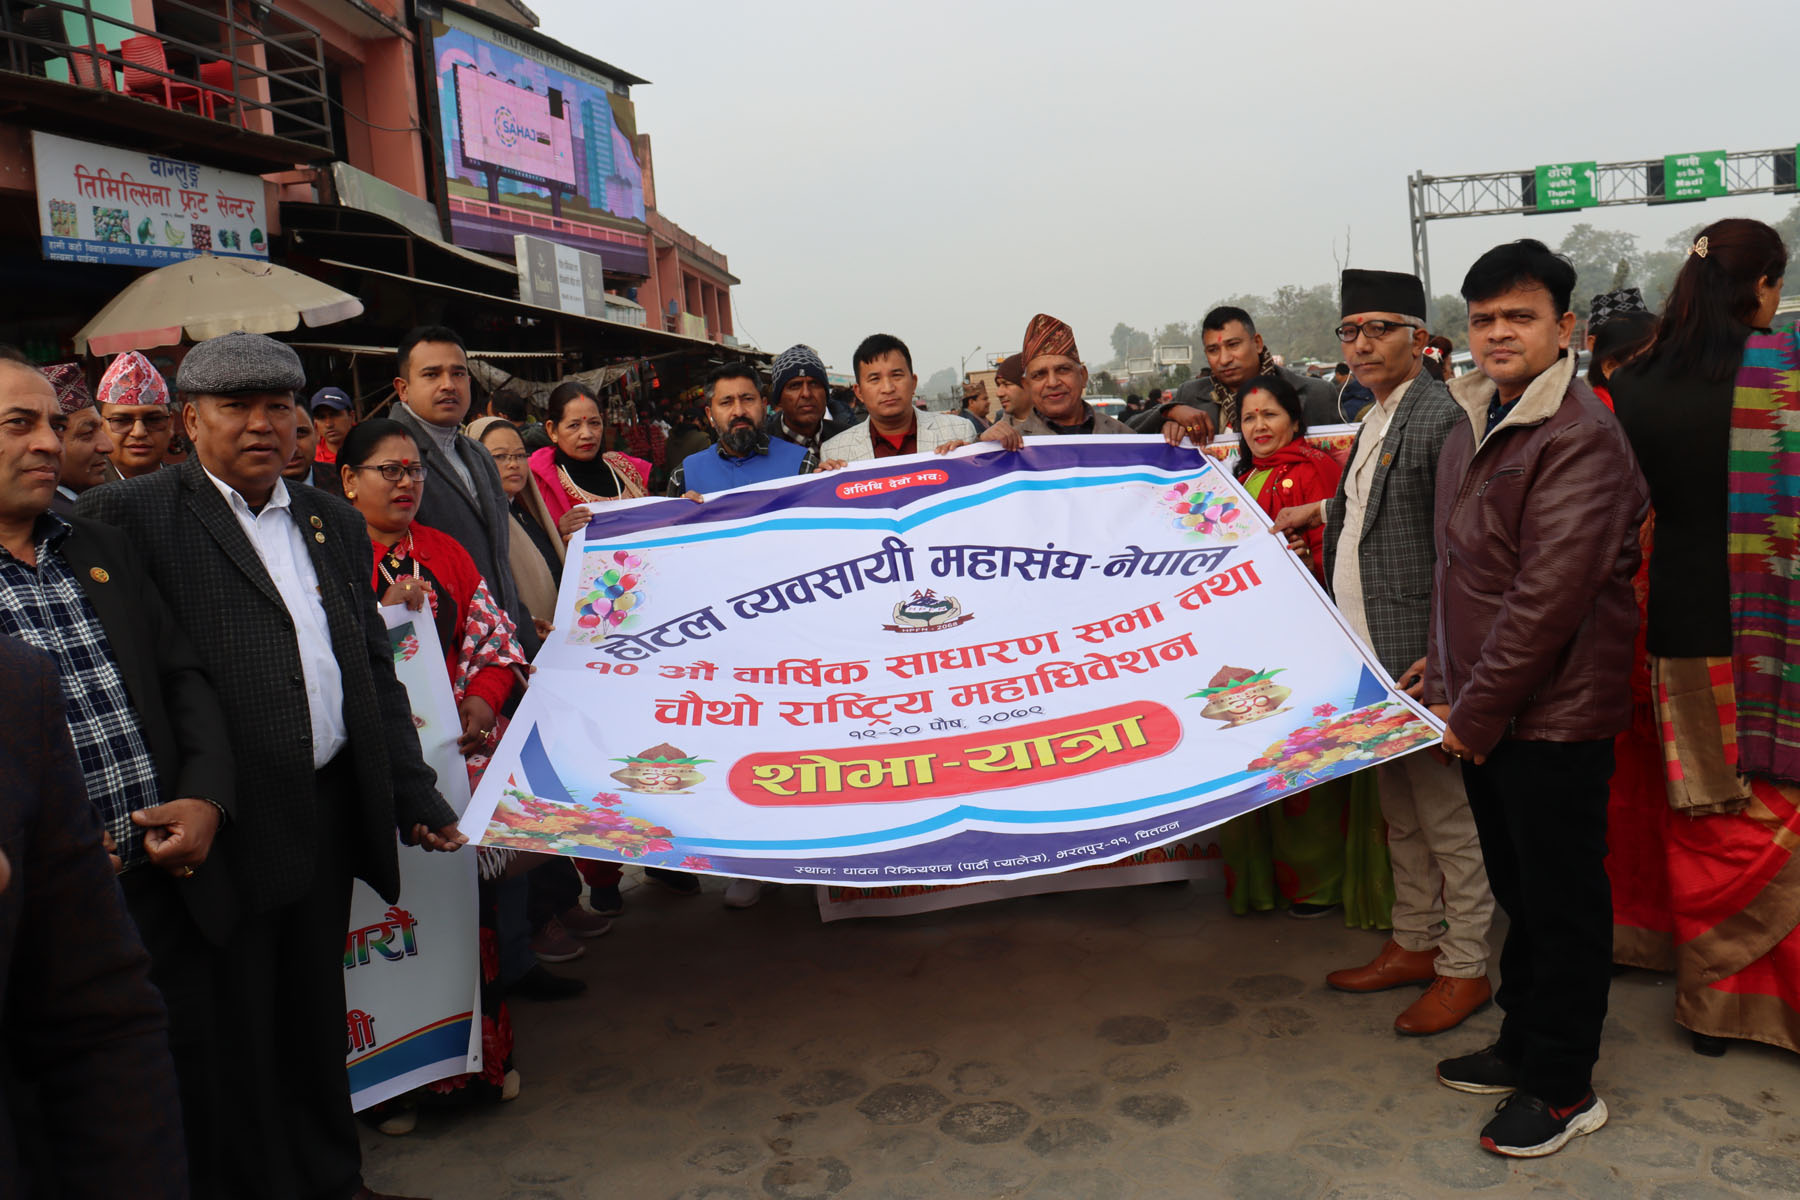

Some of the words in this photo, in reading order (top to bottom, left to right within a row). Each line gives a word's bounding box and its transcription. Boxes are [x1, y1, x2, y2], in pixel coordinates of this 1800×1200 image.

[503, 120, 536, 141] SAHAJ
[74, 164, 171, 208] तिमिल्सिना
[843, 481, 884, 495] अतिथि
[888, 477, 912, 488] देवो
[585, 661, 639, 676] १०
[733, 658, 871, 688] वार्षिक
[884, 630, 1061, 679] साधारण
[1072, 601, 1164, 643] सभा
[1174, 560, 1263, 610] तथा
[595, 606, 727, 661] होटल
[727, 536, 914, 619] व्यवसायी
[654, 690, 764, 726] चौथो
[779, 690, 934, 727] राष्ट्रिय
[949, 632, 1199, 706] महाधिवेशन
[793, 866, 837, 875] स्थान:
[1134, 820, 1180, 841] चितवन
